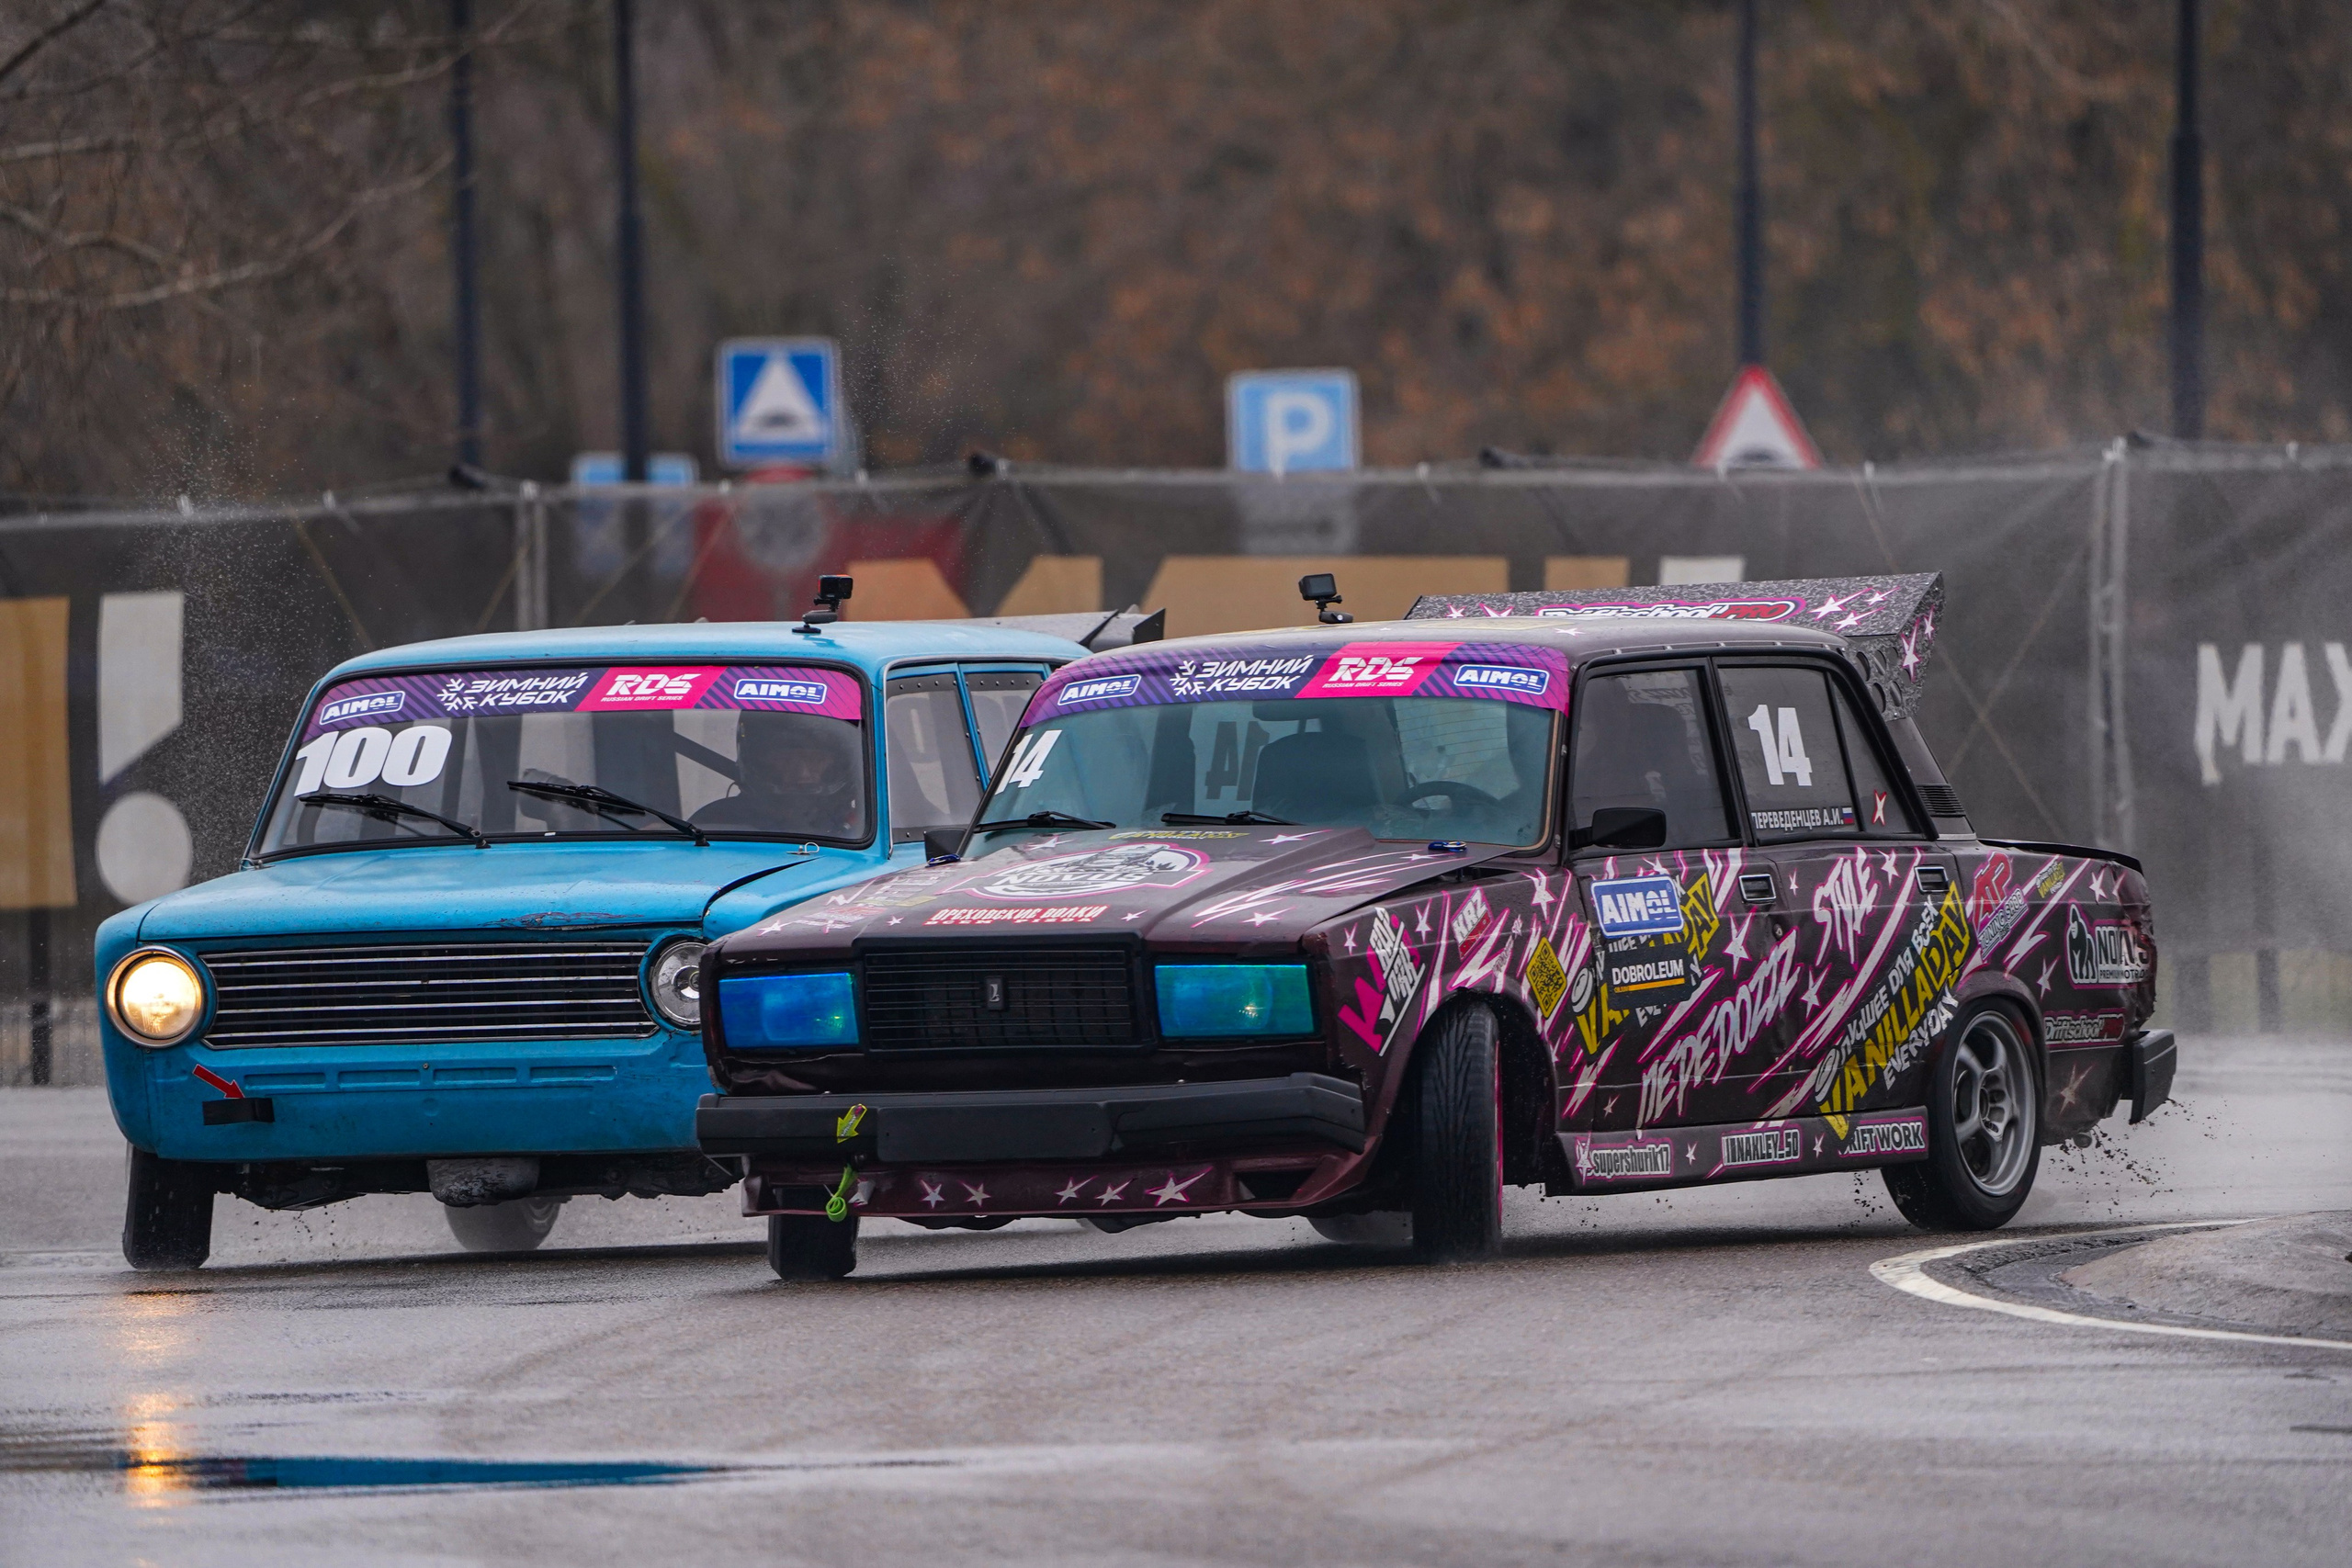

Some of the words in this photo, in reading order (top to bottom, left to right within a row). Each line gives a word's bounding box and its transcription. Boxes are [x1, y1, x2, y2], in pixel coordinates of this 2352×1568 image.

[1194, 655, 1315, 678] ЗИМНИЙ
[1329, 656, 1423, 682] RDS
[464, 671, 589, 694] ЗИМНИЙ
[605, 673, 702, 696] RDS
[738, 682, 821, 700] AIMOL
[1062, 680, 1134, 702] AIMOL
[1205, 676, 1300, 693] КУБОК
[1458, 670, 1543, 690] AIMOL
[322, 695, 399, 720] AIMOL
[479, 690, 575, 707] КУБОК
[1747, 704, 1813, 786] 14
[294, 725, 453, 796] 100
[995, 729, 1062, 795] 14
[1823, 807, 1844, 826] А.И.
[992, 871, 1153, 886] NOVUS
[931, 908, 1042, 921] ОРЕХОВСКИЕ
[1040, 905, 1108, 919] ВОЛКИ
[1600, 889, 1679, 925] AIMOL
[1979, 909, 2007, 948] TUNING
[2005, 888, 2025, 921] SHOP
[1611, 958, 1685, 986] DOBROLEUM
[1883, 978, 1959, 1090] EVERYDAY
[1875, 1124, 1925, 1150] WORK
